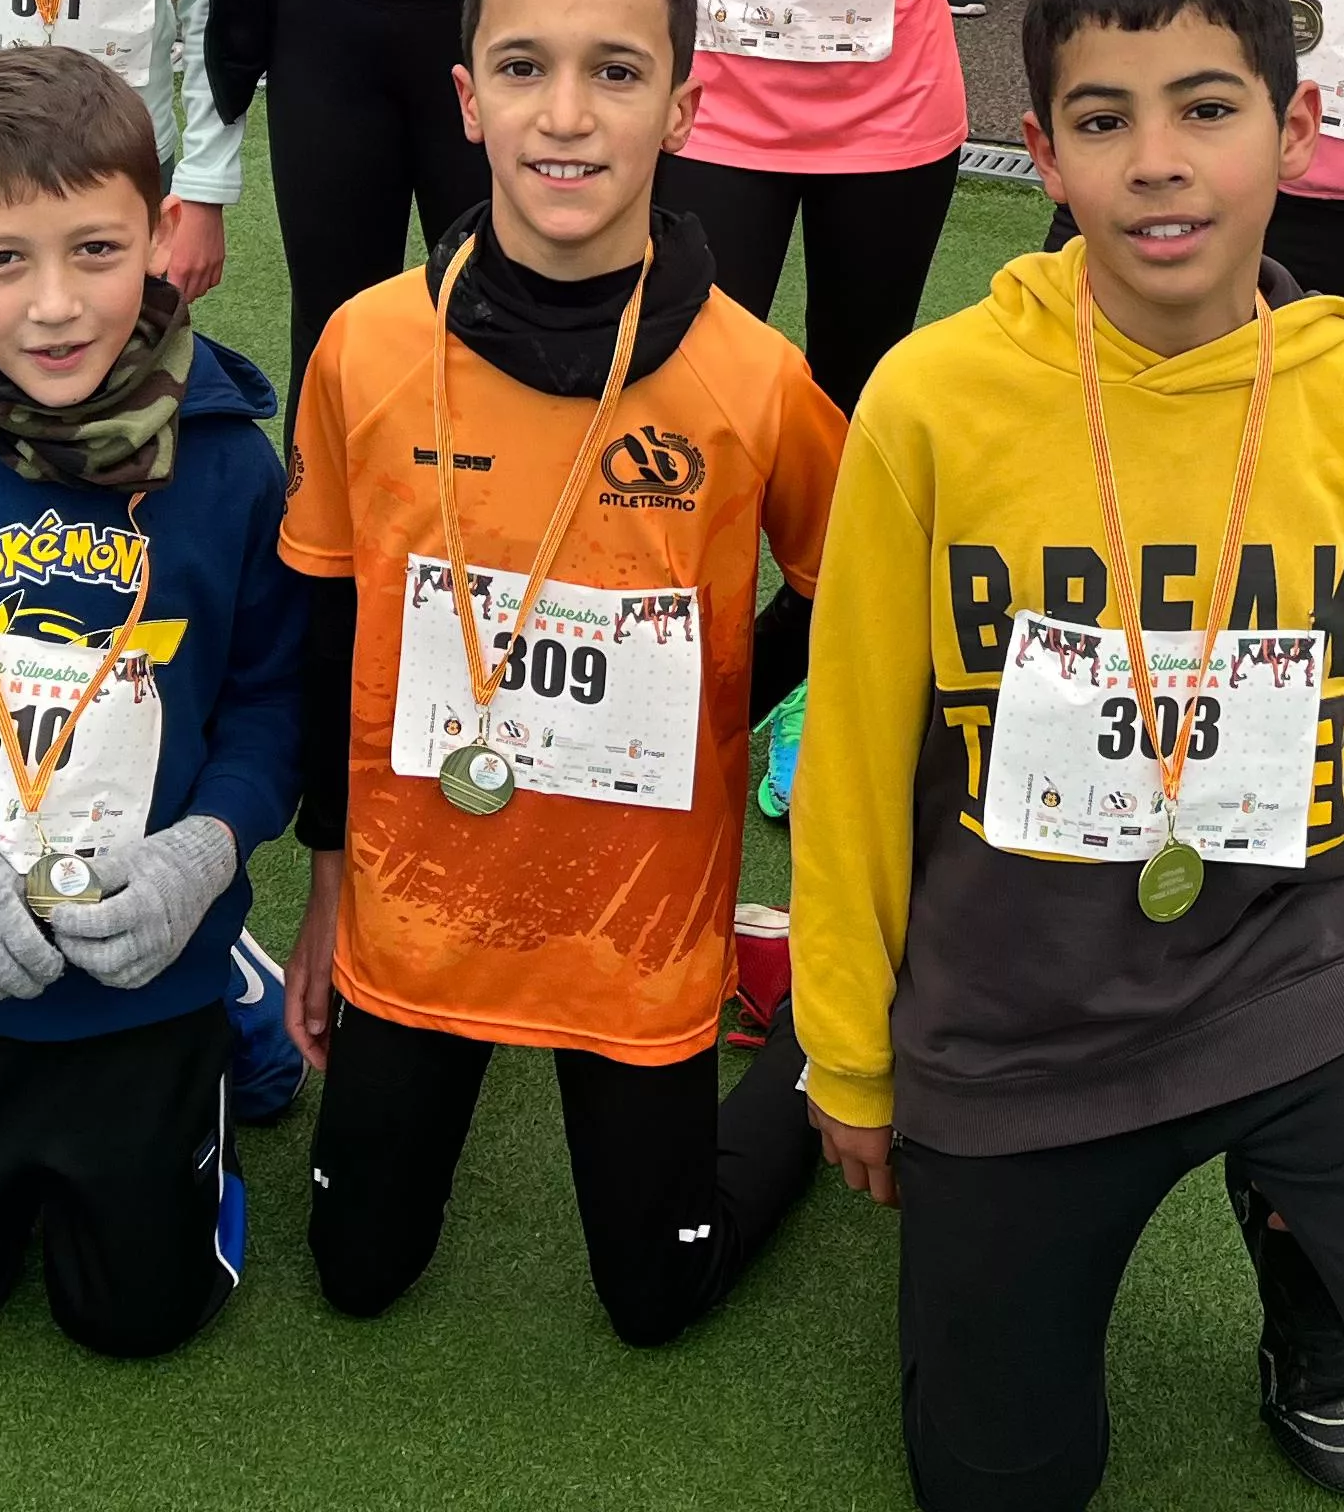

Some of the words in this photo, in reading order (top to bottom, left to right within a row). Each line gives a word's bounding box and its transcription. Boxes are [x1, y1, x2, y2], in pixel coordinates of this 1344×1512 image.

[599, 492, 696, 512] ATLETISMO
[496, 593, 519, 610] Sa
[535, 600, 611, 626] Silvestre
[498, 613, 604, 641] PÑERA
[12, 659, 90, 684] Silvestre
[492, 631, 607, 705] 309
[1106, 654, 1129, 672] Sa
[1148, 654, 1227, 671] Silvesre
[1097, 695, 1221, 761] 303
